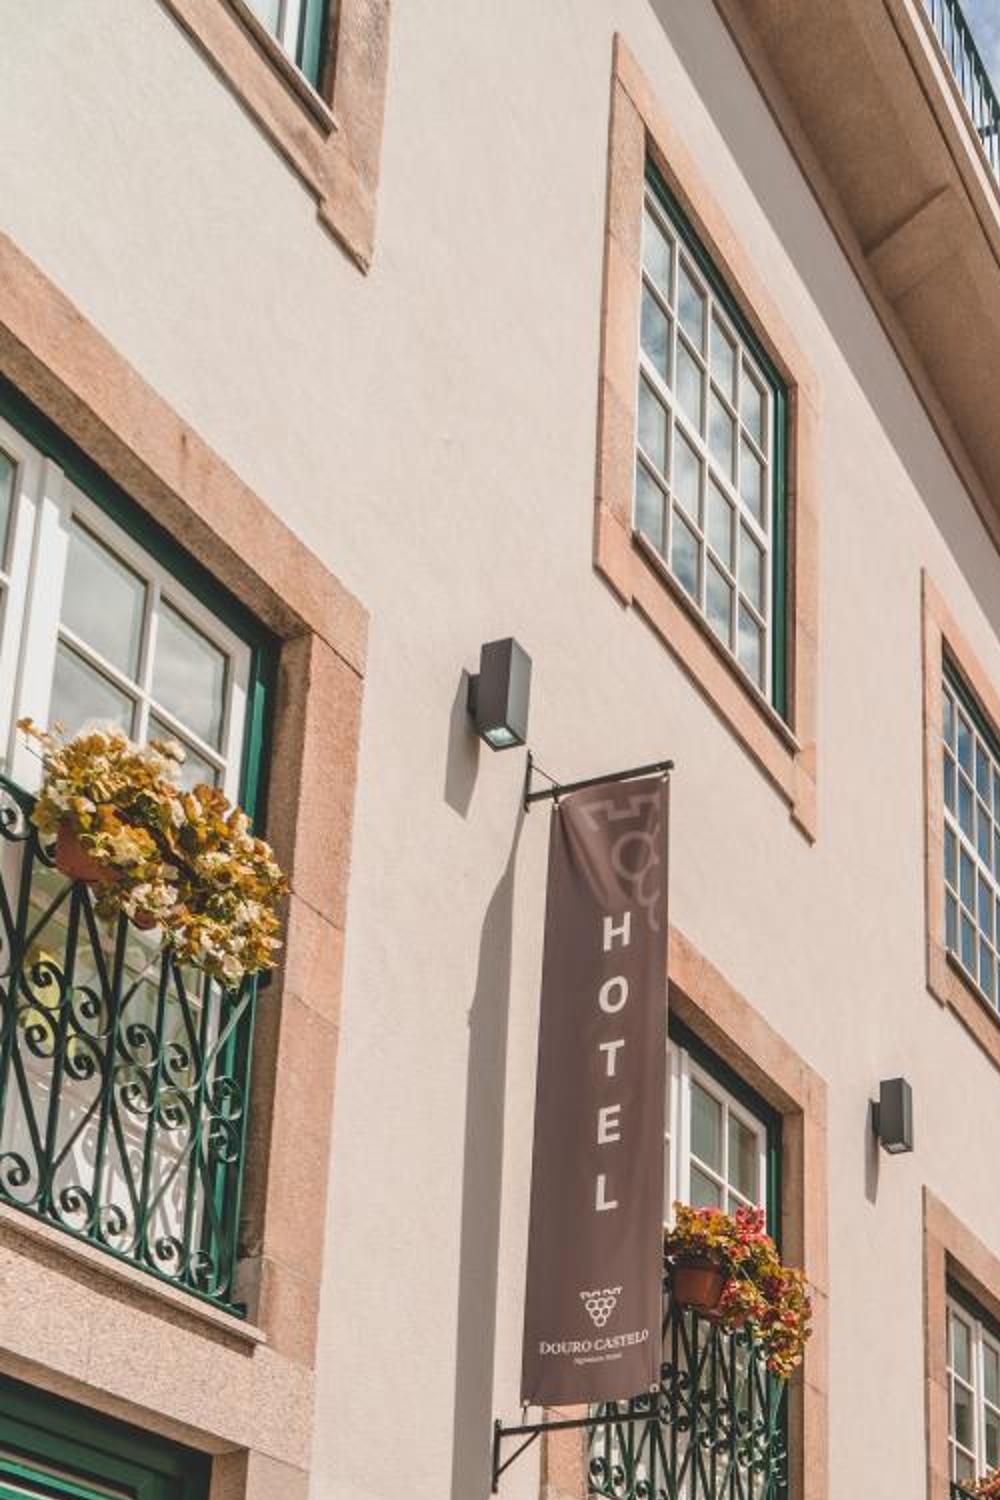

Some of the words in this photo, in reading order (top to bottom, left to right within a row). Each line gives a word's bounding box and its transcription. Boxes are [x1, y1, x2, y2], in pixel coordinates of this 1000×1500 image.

[595, 911, 631, 1212] HOTEL
[540, 1341, 592, 1355] DOURO
[594, 1328, 649, 1351] CASTELO
